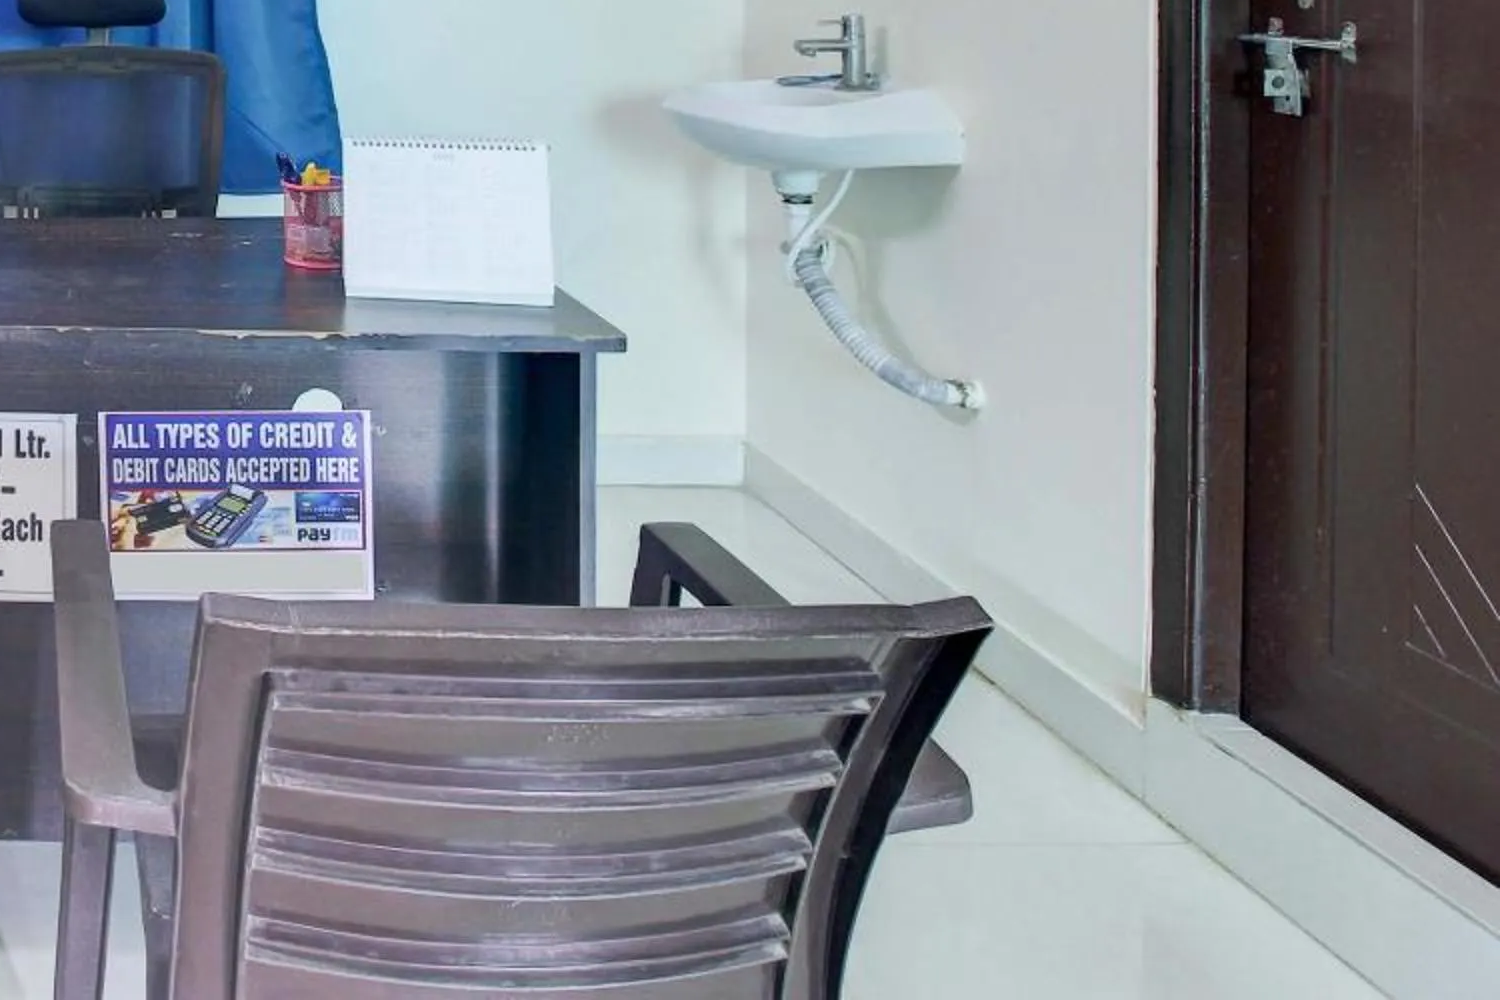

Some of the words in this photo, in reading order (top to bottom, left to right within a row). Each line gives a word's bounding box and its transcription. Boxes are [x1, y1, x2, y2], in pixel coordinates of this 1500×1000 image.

[14, 428, 51, 459] Ltr.
[112, 423, 151, 449] ALL
[156, 423, 220, 449] TYPES
[227, 422, 253, 449] OF
[259, 422, 335, 449] CREDIT
[341, 422, 357, 449] &
[113, 457, 159, 483] DEBIT
[164, 457, 220, 483] CARDS
[226, 457, 311, 483] ACCEPTED
[316, 457, 360, 483] HERE
